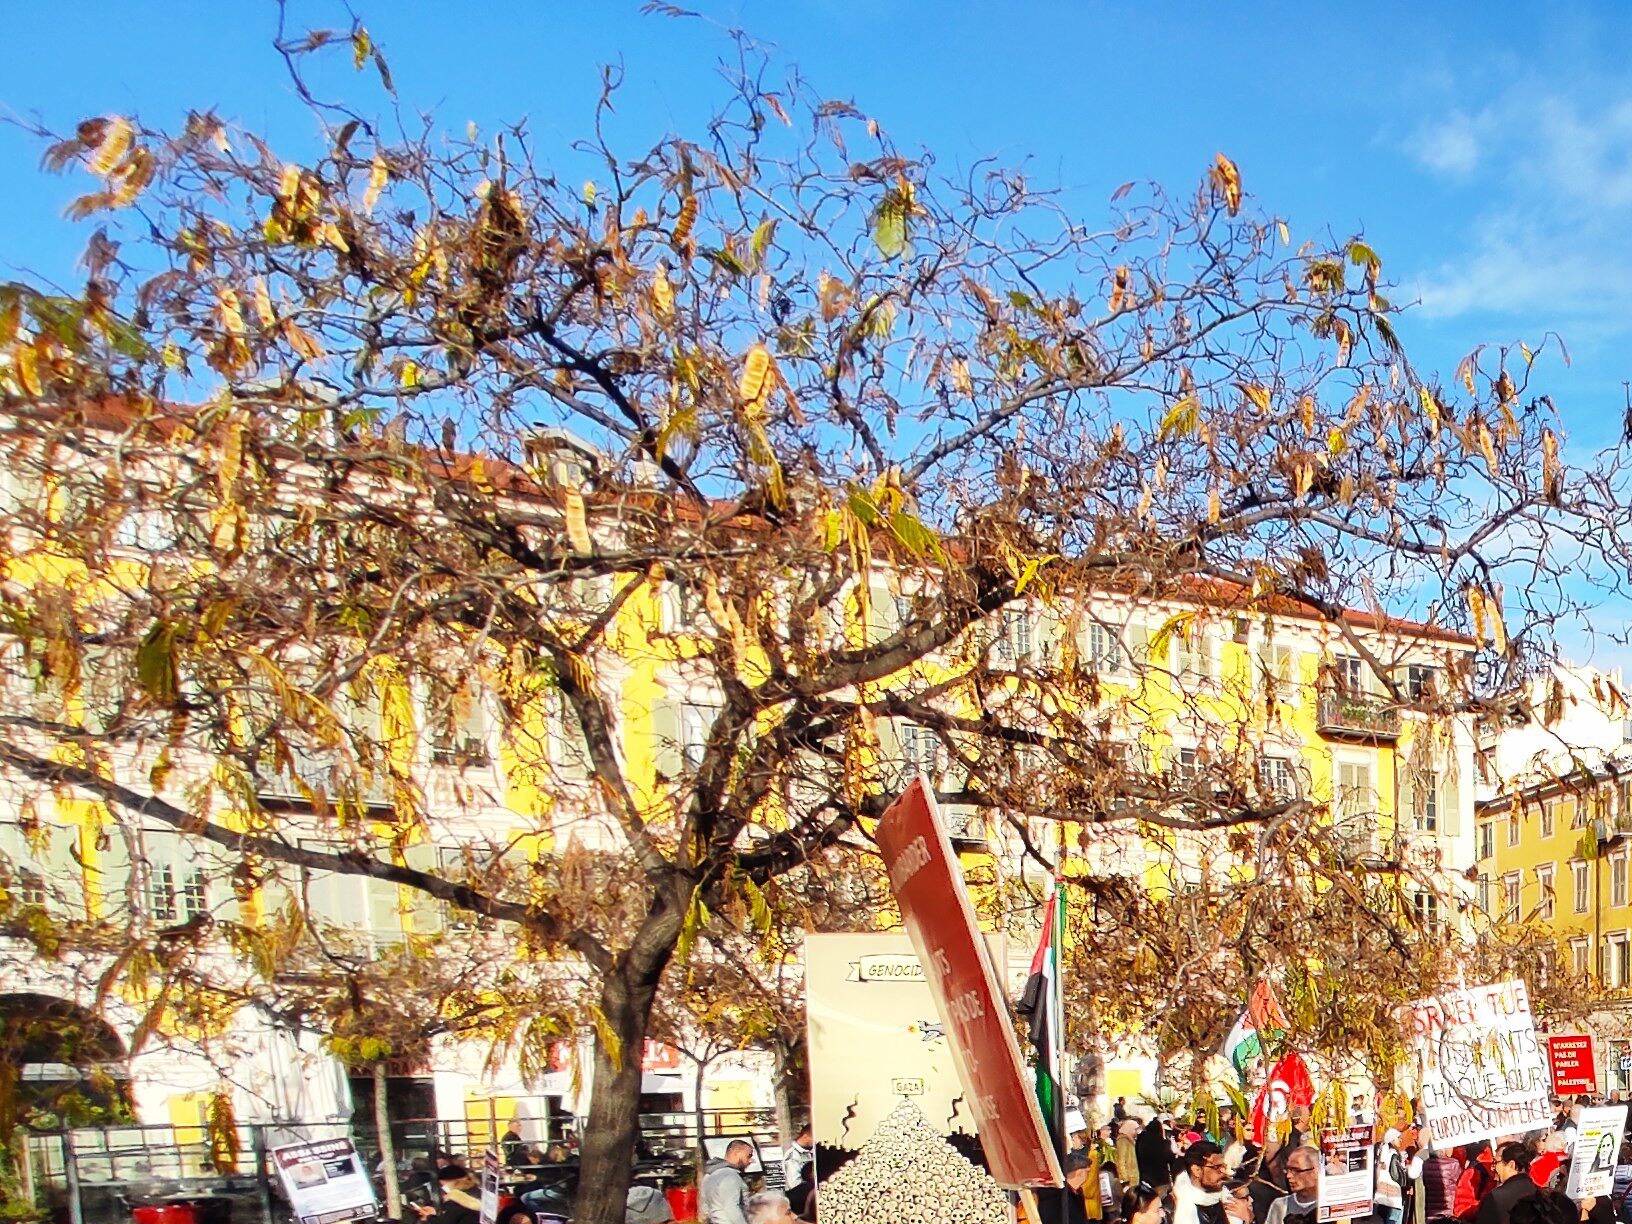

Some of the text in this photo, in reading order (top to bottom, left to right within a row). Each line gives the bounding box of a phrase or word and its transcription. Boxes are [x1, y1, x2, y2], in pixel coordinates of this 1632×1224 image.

[868, 964, 926, 977] GENOCID
[1430, 1115, 1476, 1141] EUROPE
[1481, 1097, 1550, 1130] COMPLICE
